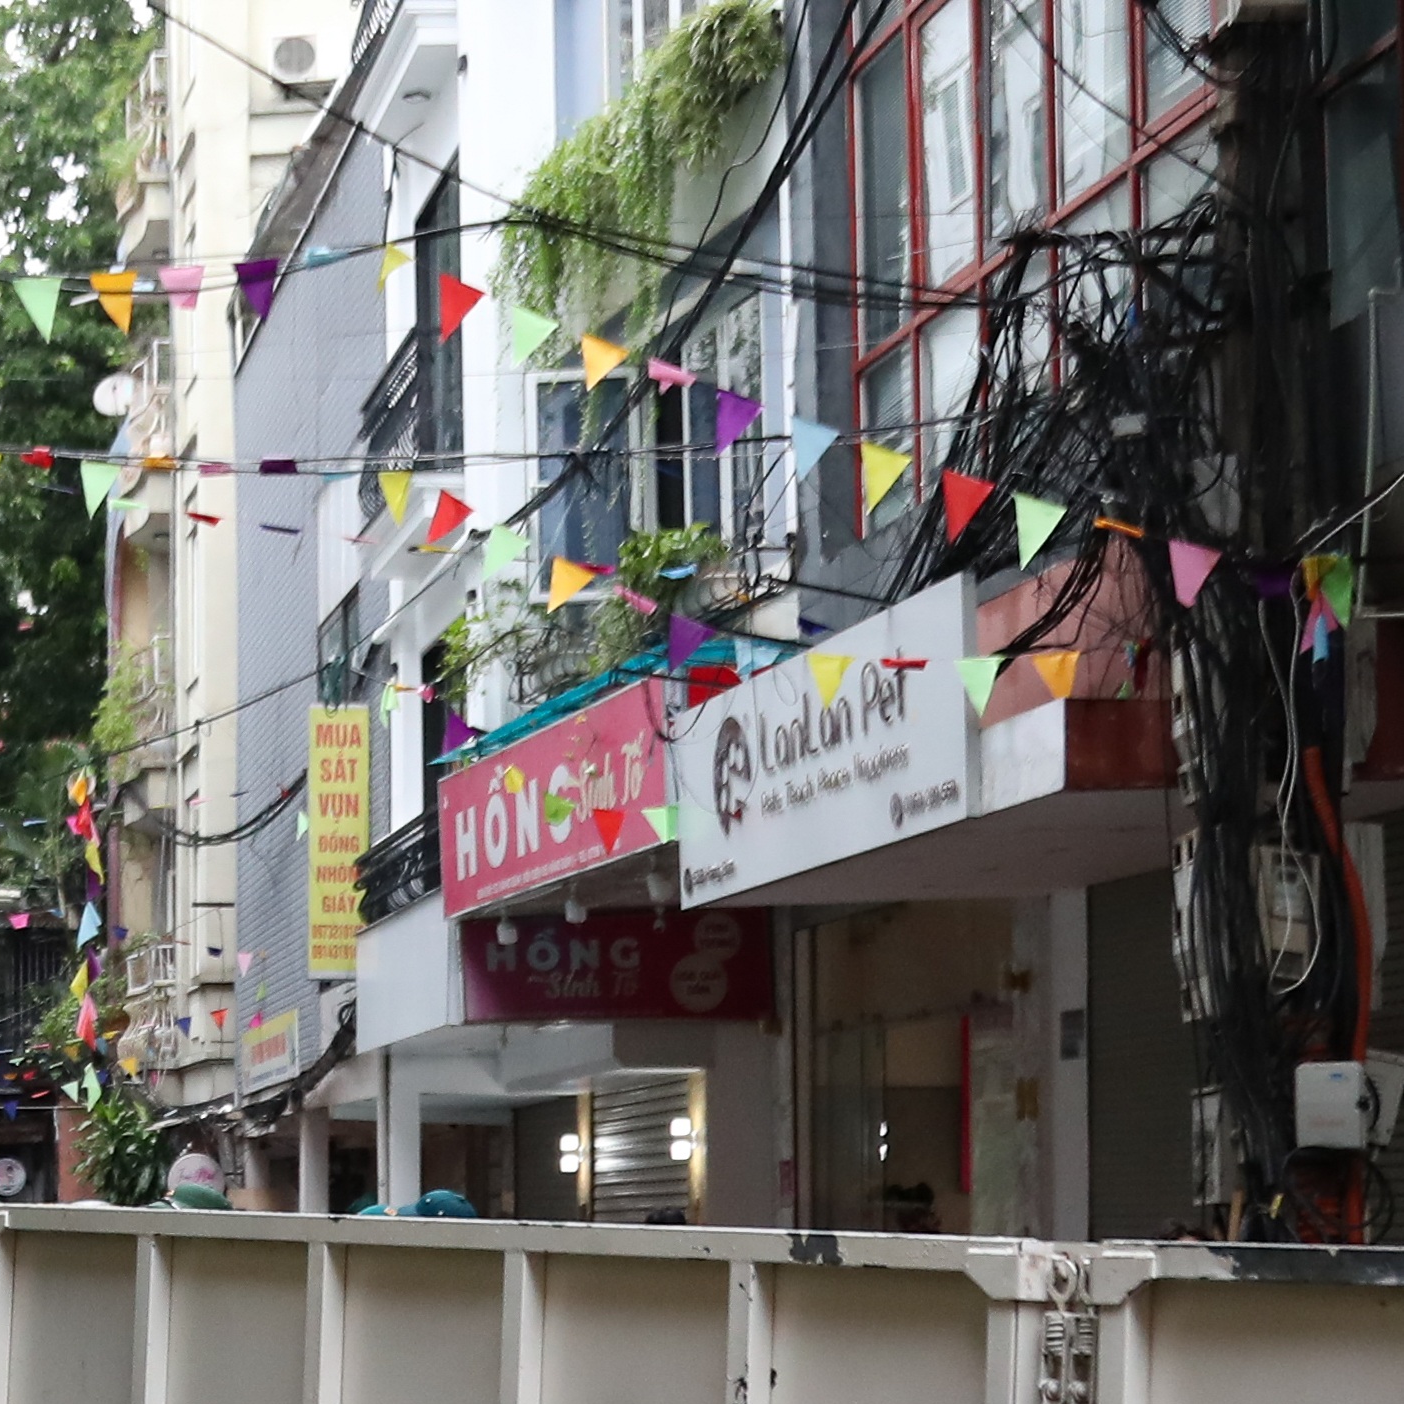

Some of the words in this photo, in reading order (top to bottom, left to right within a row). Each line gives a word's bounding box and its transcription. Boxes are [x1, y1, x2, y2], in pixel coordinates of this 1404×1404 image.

[860, 646, 908, 736] Pet
[316, 723, 362, 747] MUA
[318, 793, 360, 824] VỤN
